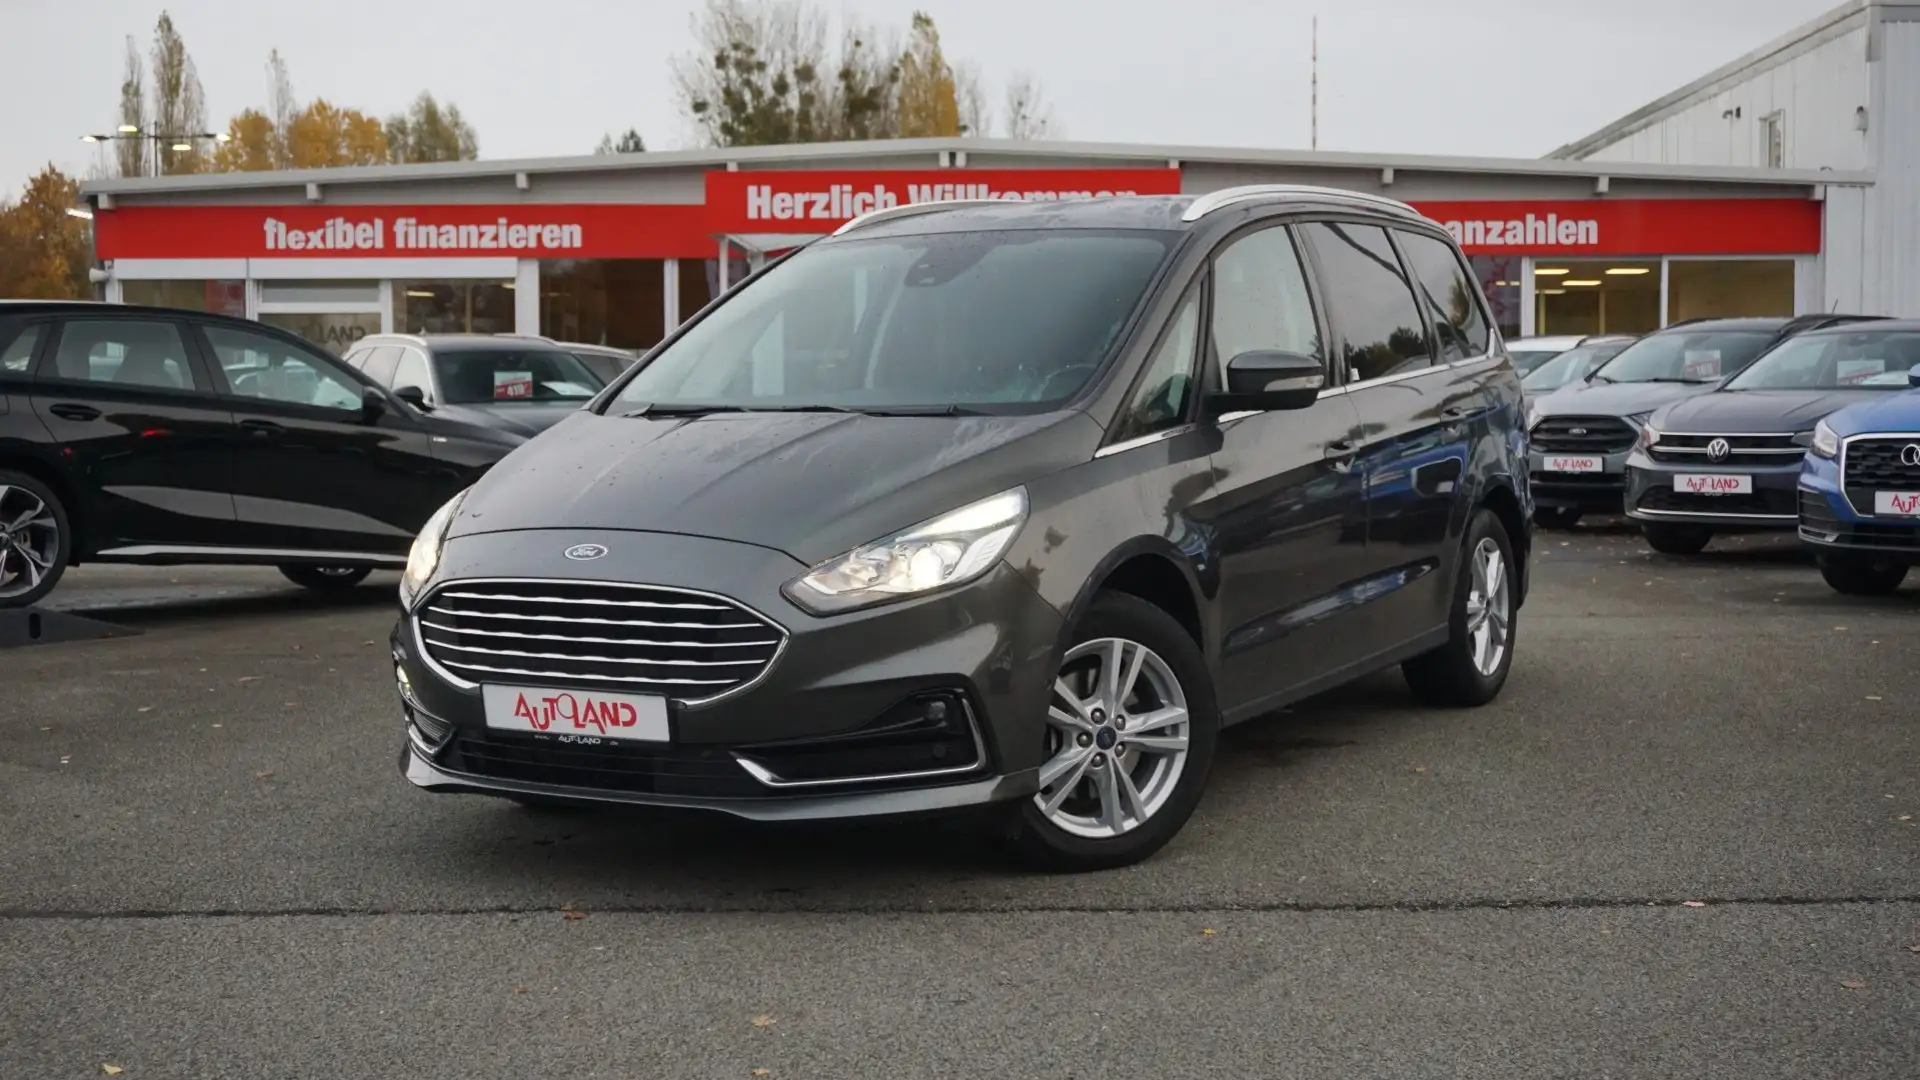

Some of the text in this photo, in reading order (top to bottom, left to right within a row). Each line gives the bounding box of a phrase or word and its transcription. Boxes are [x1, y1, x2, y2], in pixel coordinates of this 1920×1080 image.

[747, 184, 897, 219] Herzlich
[264, 217, 582, 249] flexibel finanzieren
[1444, 213, 1599, 245] anzahlen
[1687, 476, 1740, 492] AUTOLAND
[1891, 493, 1920, 513] AUT
[572, 546, 599, 557] Ford
[514, 692, 637, 735] AUTOLAND
[558, 734, 601, 745] AUTOLAND
